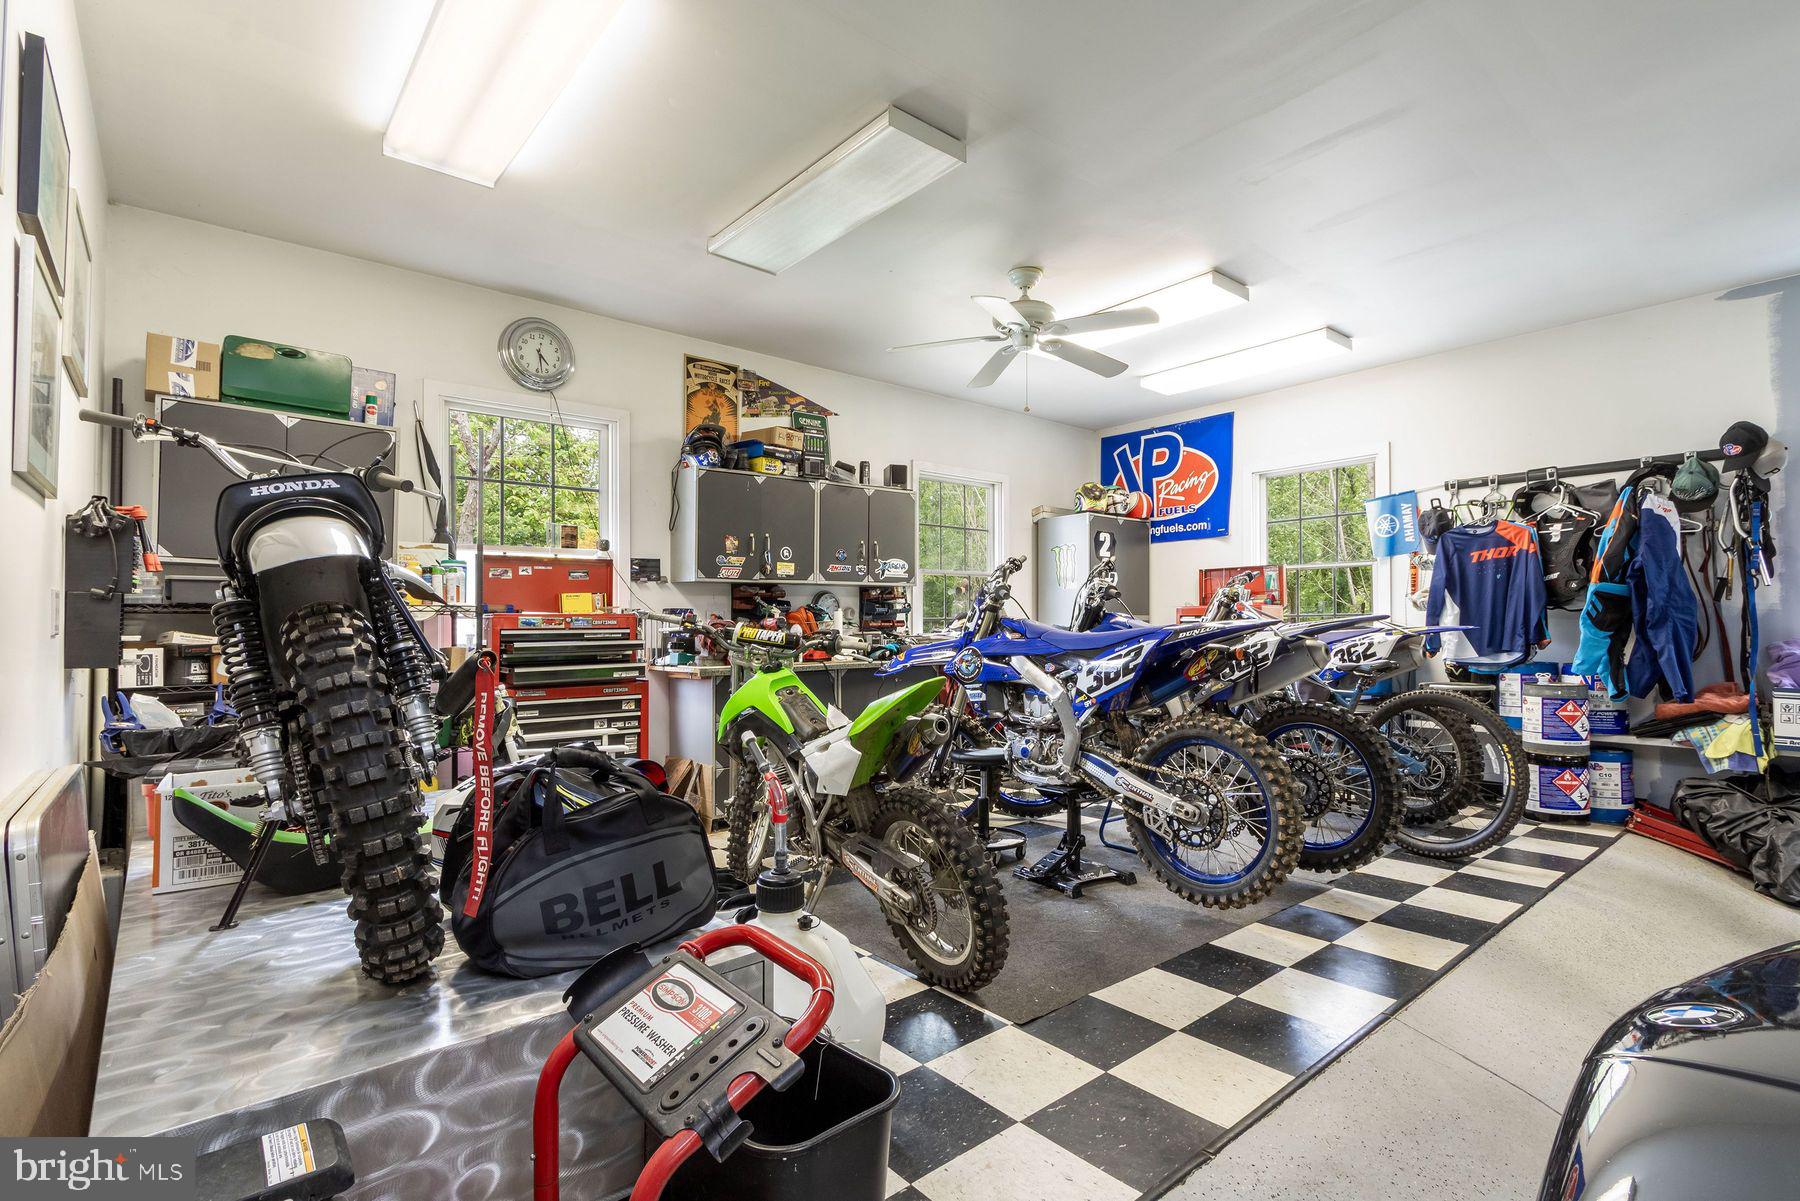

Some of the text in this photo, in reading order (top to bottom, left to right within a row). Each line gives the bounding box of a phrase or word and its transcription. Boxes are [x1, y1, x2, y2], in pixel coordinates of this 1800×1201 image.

[250, 479, 341, 497] HONDA
[1158, 470, 1216, 507] Racing
[1158, 503, 1198, 517] FUELS
[1151, 521, 1208, 537] ngfuels.com
[1100, 532, 1111, 557] 2
[722, 569, 740, 577] KLOTZ
[1333, 639, 1378, 664] 362
[1502, 743, 1516, 787] MAXXIS
[199, 789, 232, 800] Tito's
[471, 691, 491, 901] REMOVE BEFORE FLIGHT!
[540, 860, 683, 936] BELL
[561, 899, 671, 941] HELMETS
[658, 983, 689, 1007] SIMPSON
[629, 1000, 654, 1022] PREMIUM
[692, 1003, 713, 1020] 3100
[618, 1006, 650, 1035] PRESSURE
[646, 1029, 677, 1058] WASHER
